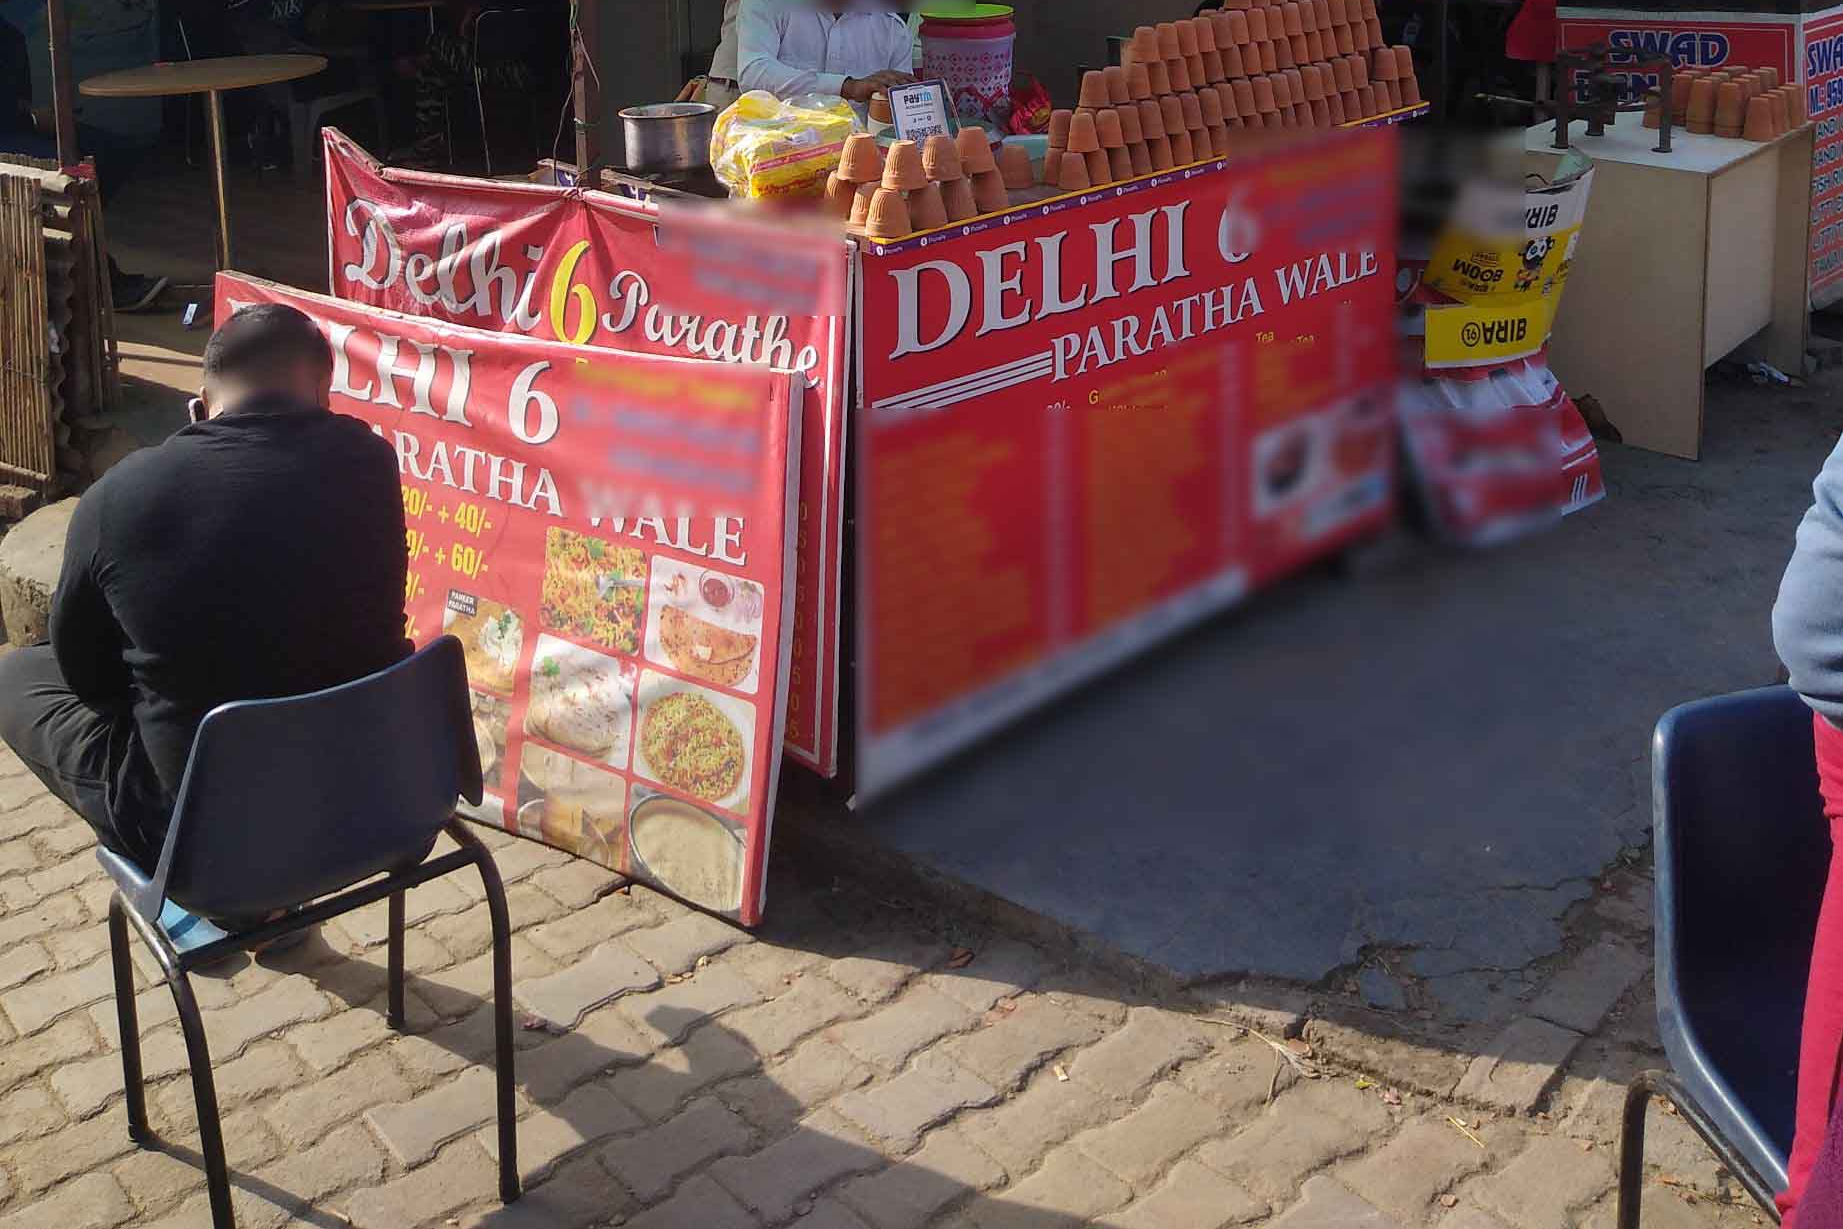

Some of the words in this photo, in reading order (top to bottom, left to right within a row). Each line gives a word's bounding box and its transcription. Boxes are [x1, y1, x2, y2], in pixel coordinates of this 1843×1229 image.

[1608, 29, 1731, 69] SWAD
[1526, 203, 1559, 229] BIR
[343, 197, 545, 331] Delhi
[549, 240, 597, 346] 6
[888, 200, 1191, 361] DELHI
[1453, 258, 1505, 283] BOOM
[1050, 277, 1265, 383] PARATHA
[1275, 248, 1379, 305] WALE
[1482, 317, 1528, 345] BIRA
[327, 320, 474, 428] LHI
[507, 360, 559, 445] 6
[372, 420, 564, 518] RATHA
[454, 501, 493, 538] 40/-
[451, 542, 490, 581] 60/-
